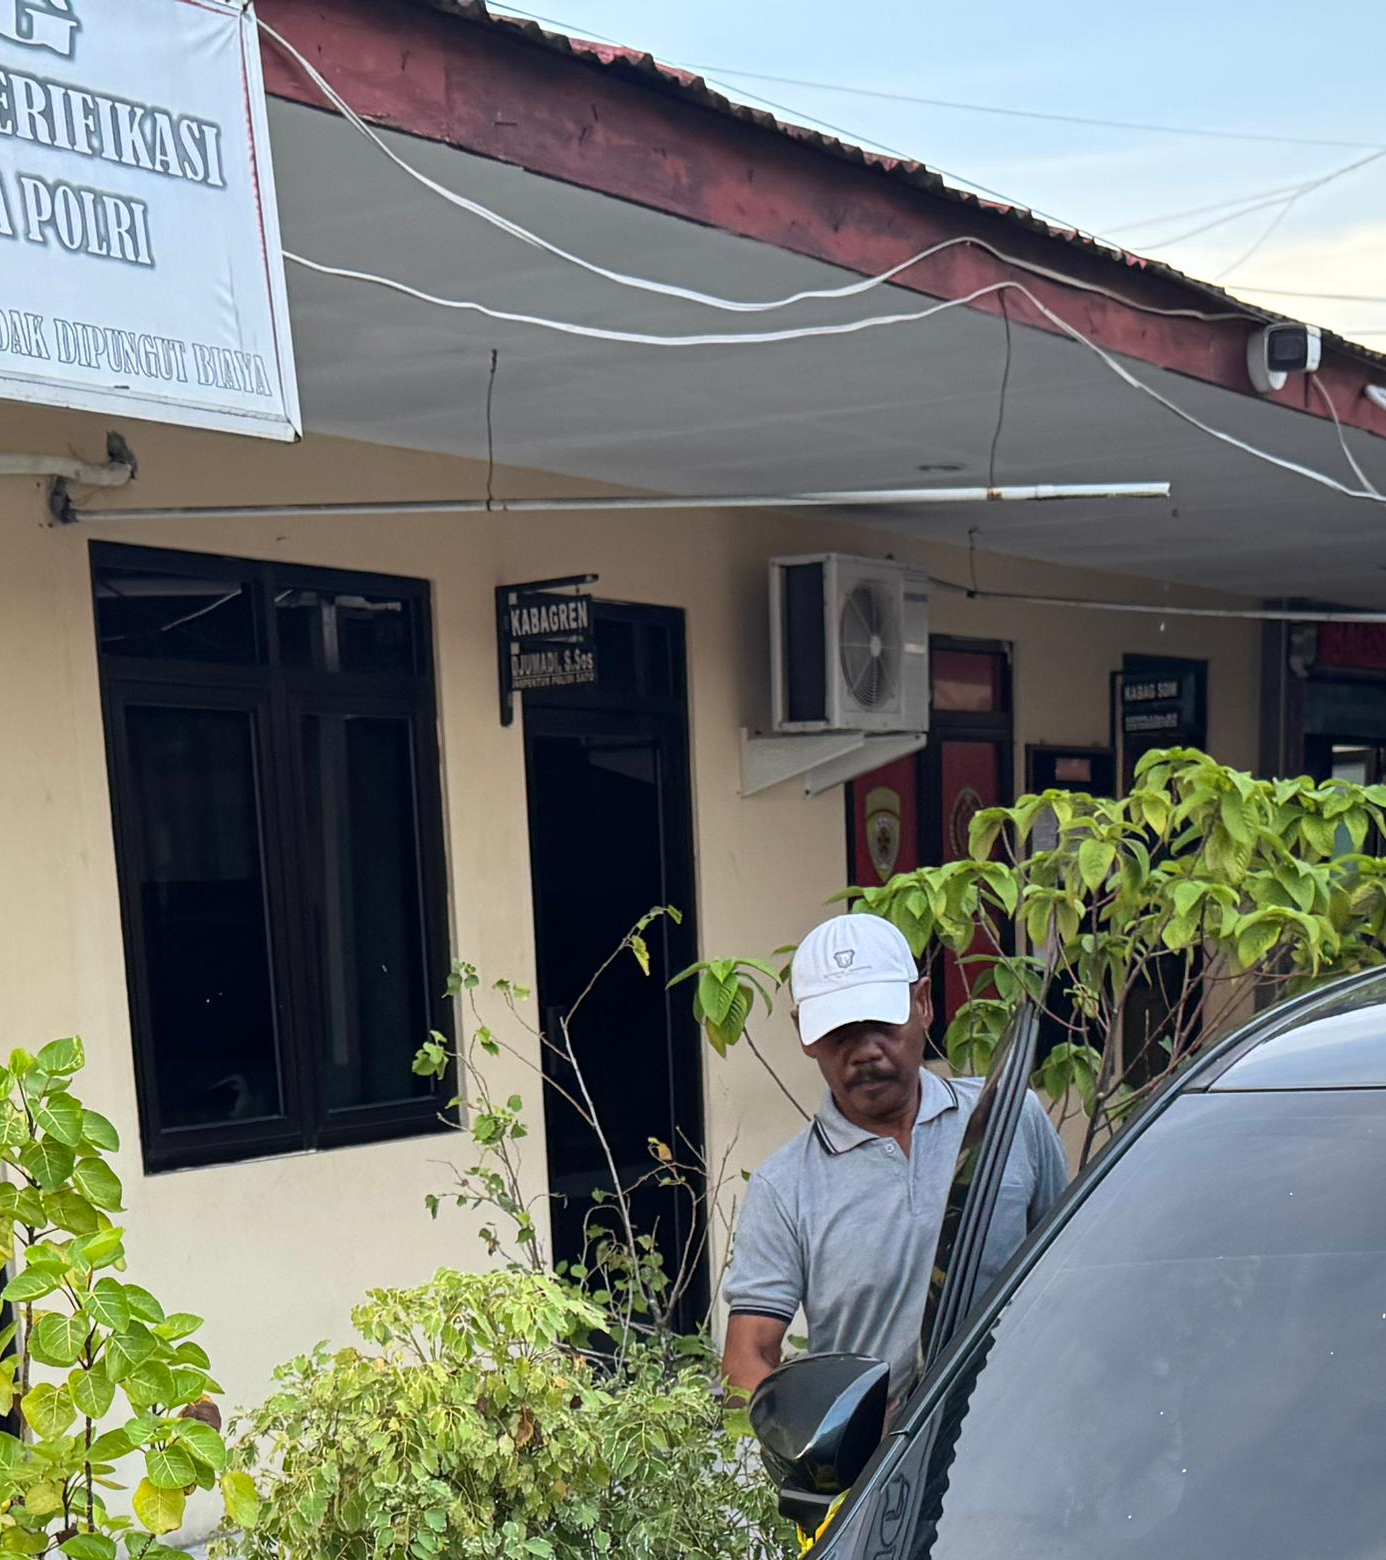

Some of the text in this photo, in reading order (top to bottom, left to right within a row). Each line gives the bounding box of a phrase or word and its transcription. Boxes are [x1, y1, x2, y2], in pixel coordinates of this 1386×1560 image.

[18, 175, 154, 266] POLRI
[53, 319, 189, 383] DIPUNGUT
[192, 342, 273, 397] BIAYA
[510, 600, 589, 637] KABAGREN
